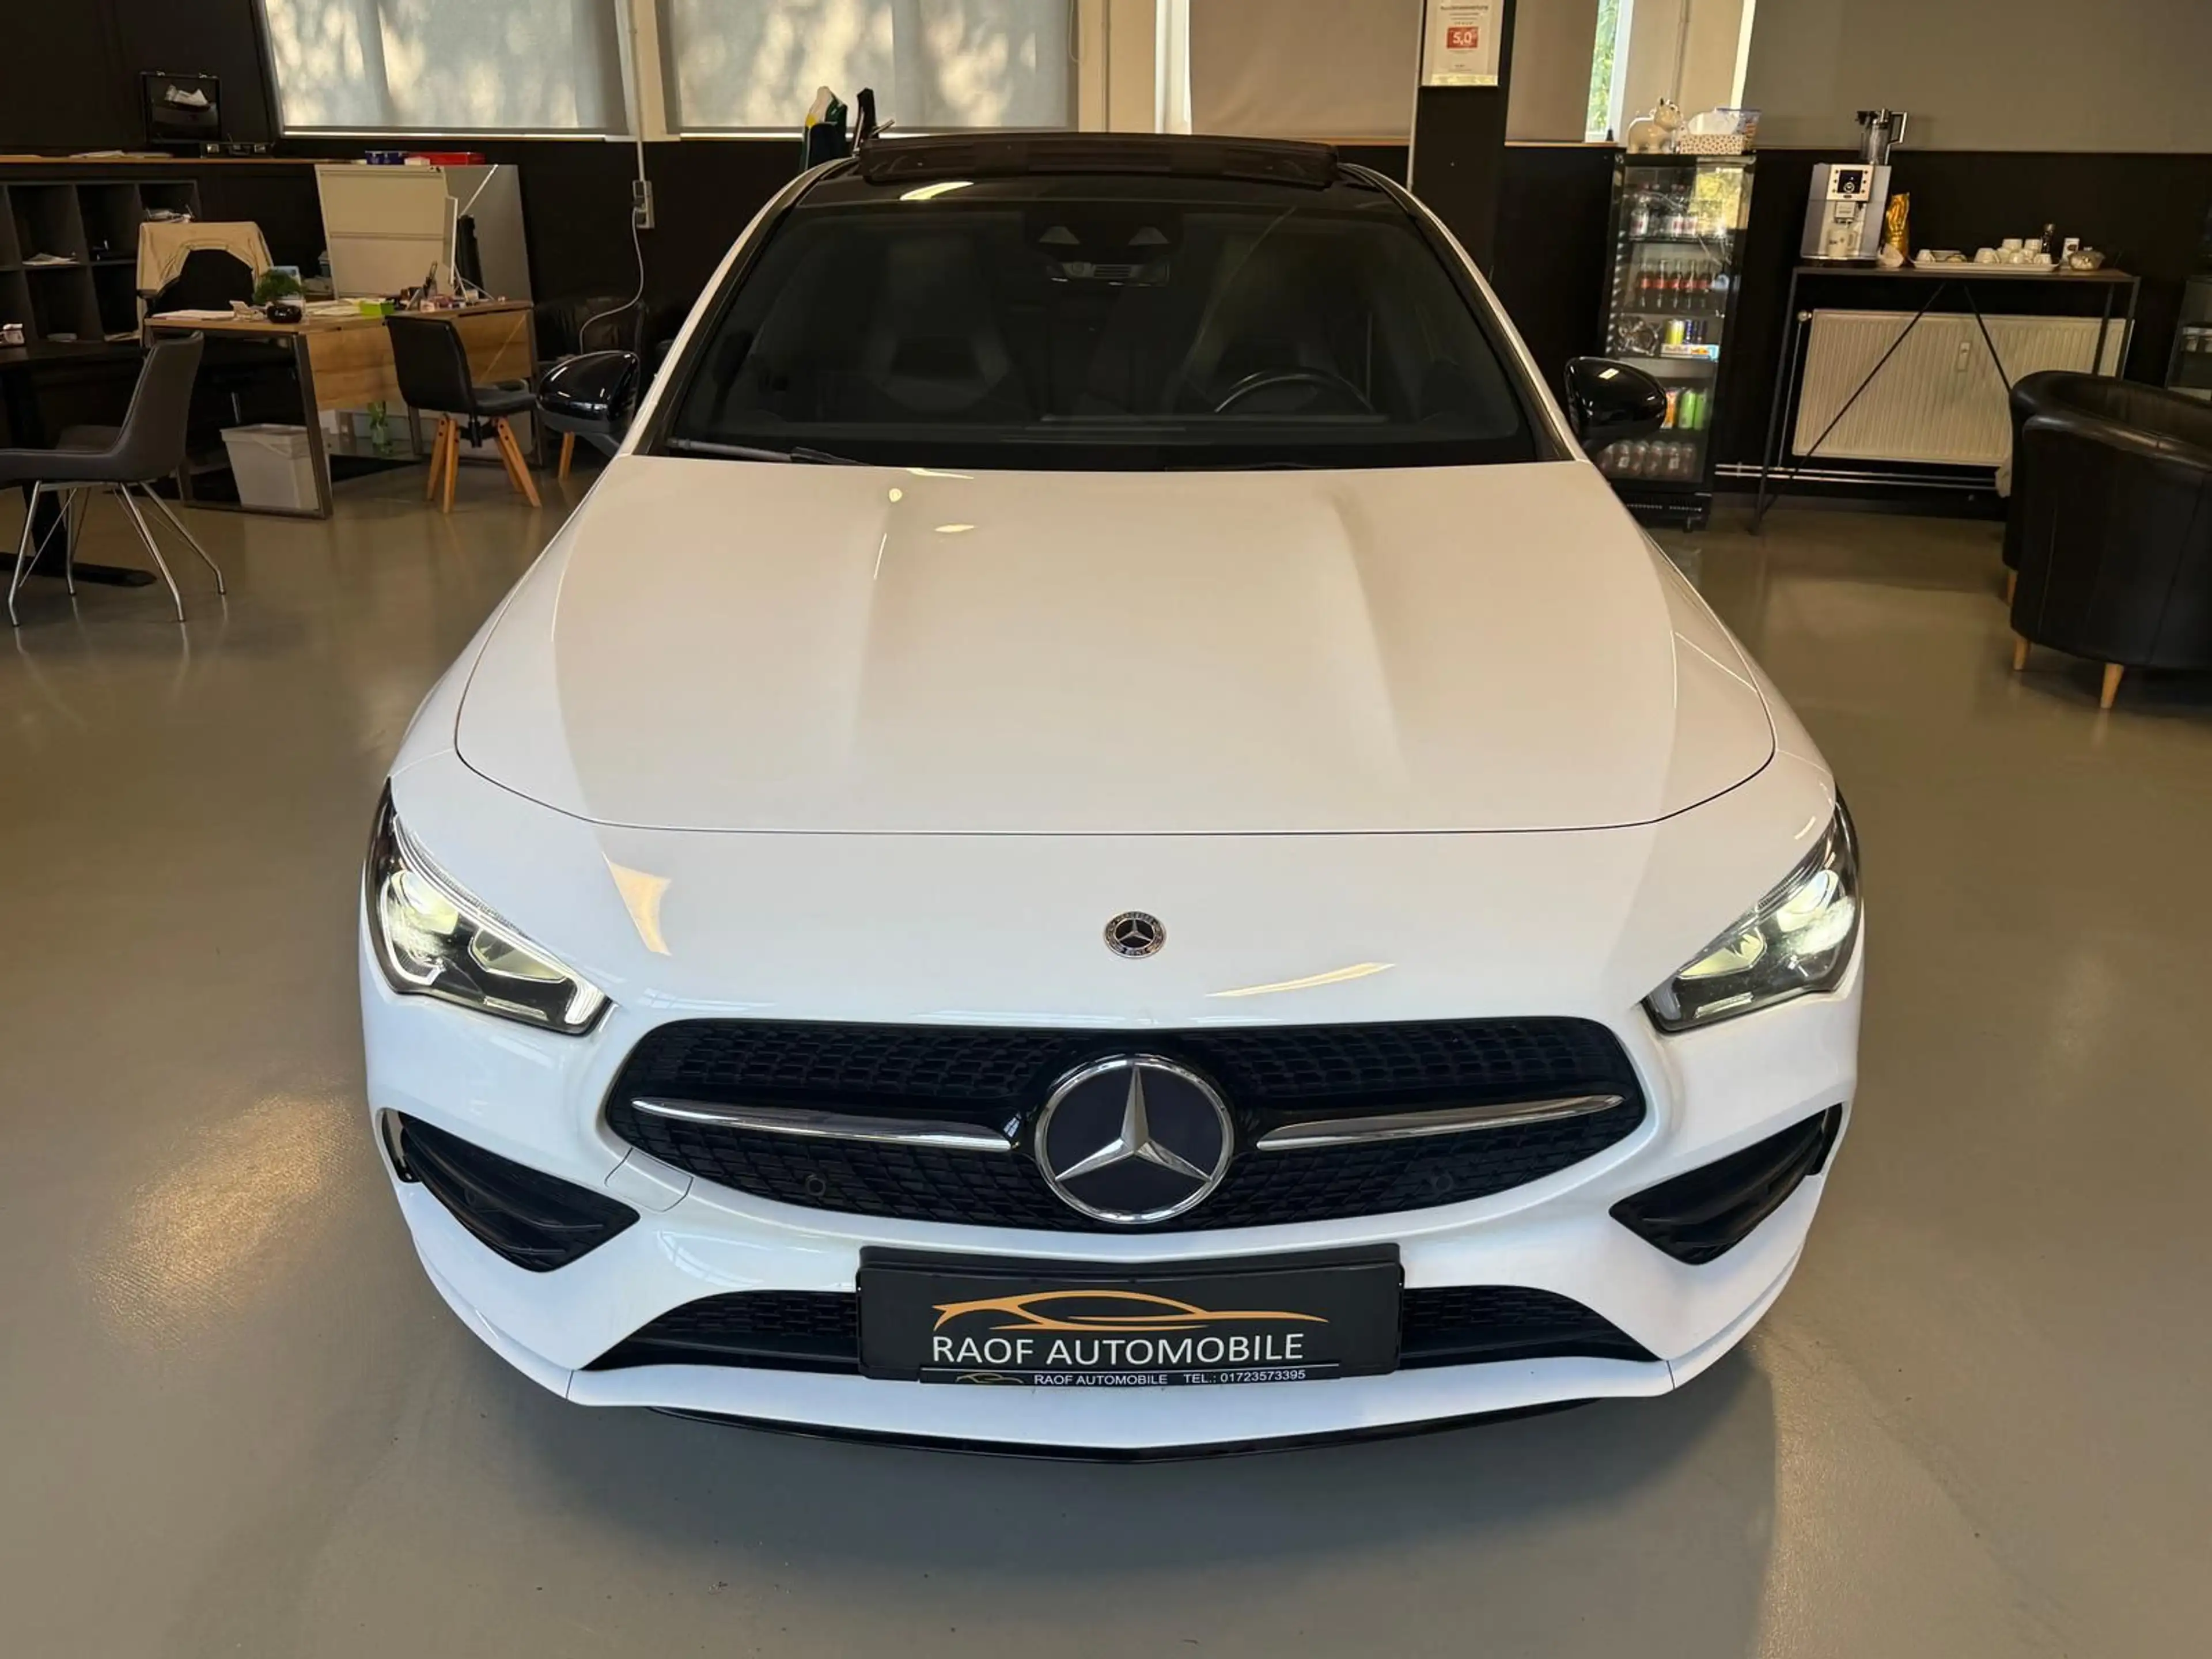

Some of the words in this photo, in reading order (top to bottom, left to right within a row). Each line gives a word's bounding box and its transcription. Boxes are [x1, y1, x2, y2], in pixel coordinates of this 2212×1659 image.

[933, 1336, 1034, 1364] RAOF
[1046, 1334, 1304, 1365] AUTOMOBILE
[1034, 1374, 1072, 1385] RAOF
[1075, 1374, 1168, 1385] AUTOMOBILE
[1220, 1369, 1306, 1382] 01723573395
